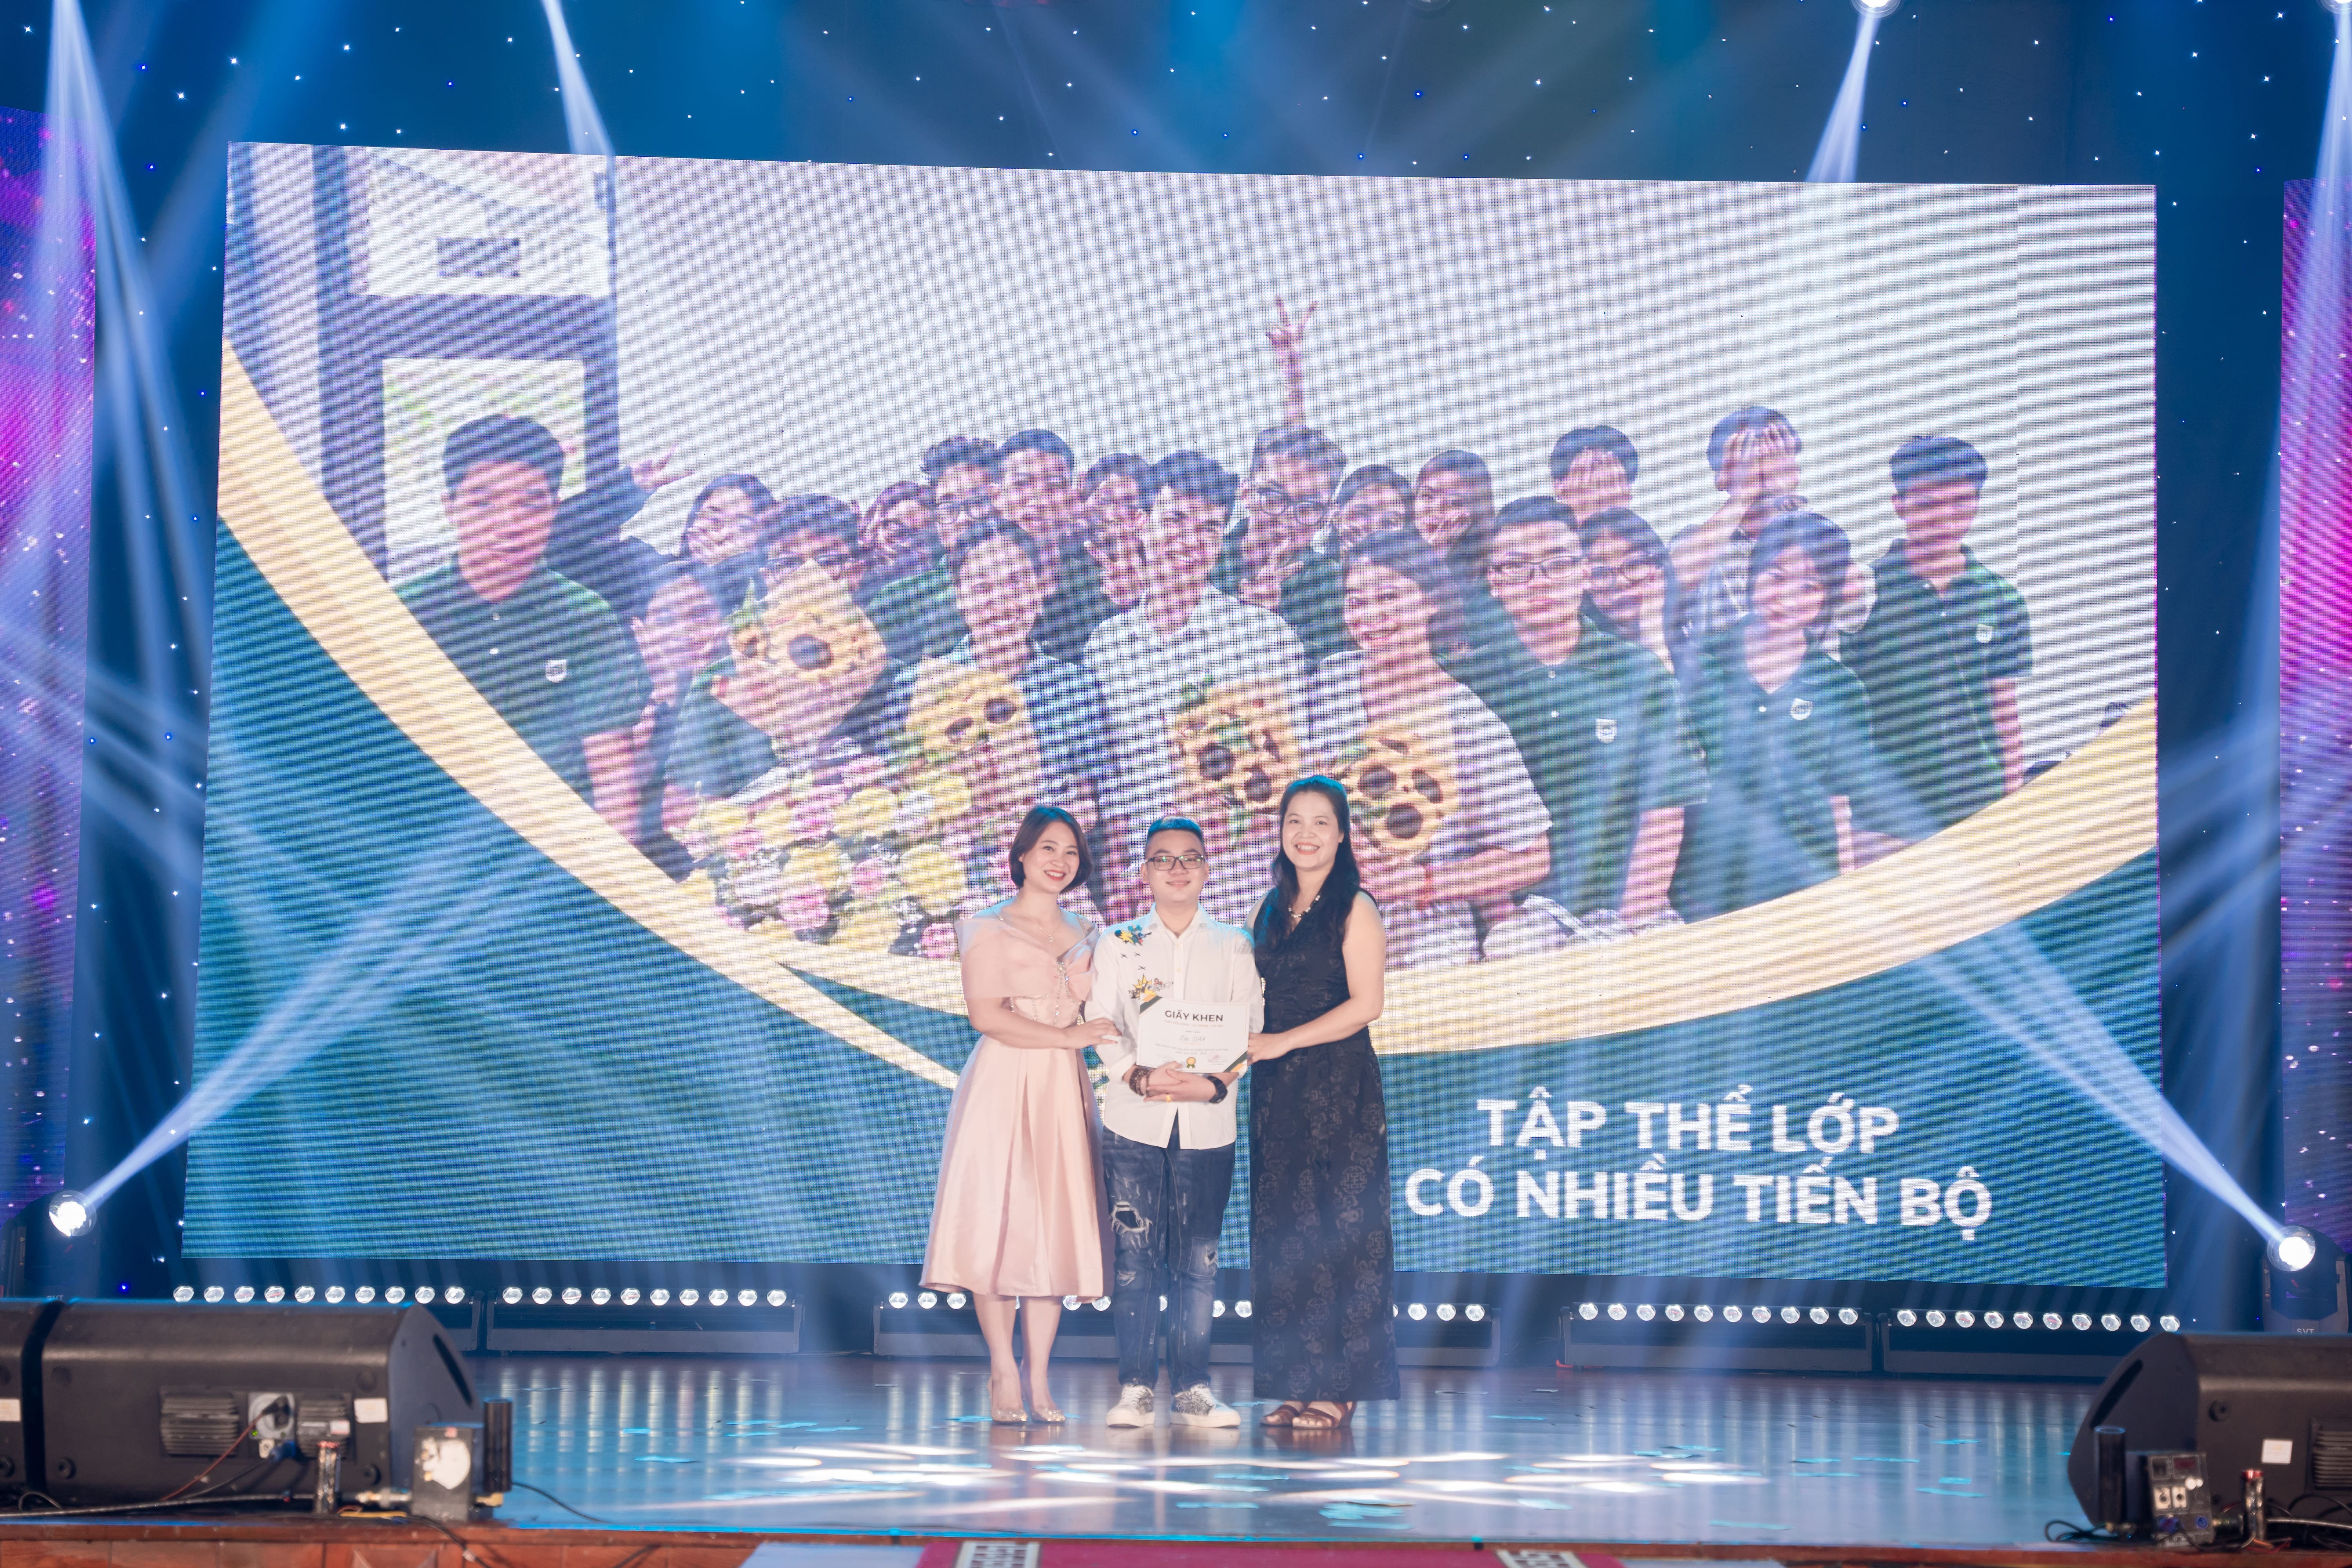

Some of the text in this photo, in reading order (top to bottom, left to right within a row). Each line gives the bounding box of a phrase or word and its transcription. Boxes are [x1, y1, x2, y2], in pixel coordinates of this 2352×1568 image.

[1165, 1010, 1189, 1020] GIẤY
[1476, 1084, 1900, 1161] TẬP THỂ LỚP
[1404, 1153, 1993, 1241] CÓ NHIỀU TIẾN BỘ
